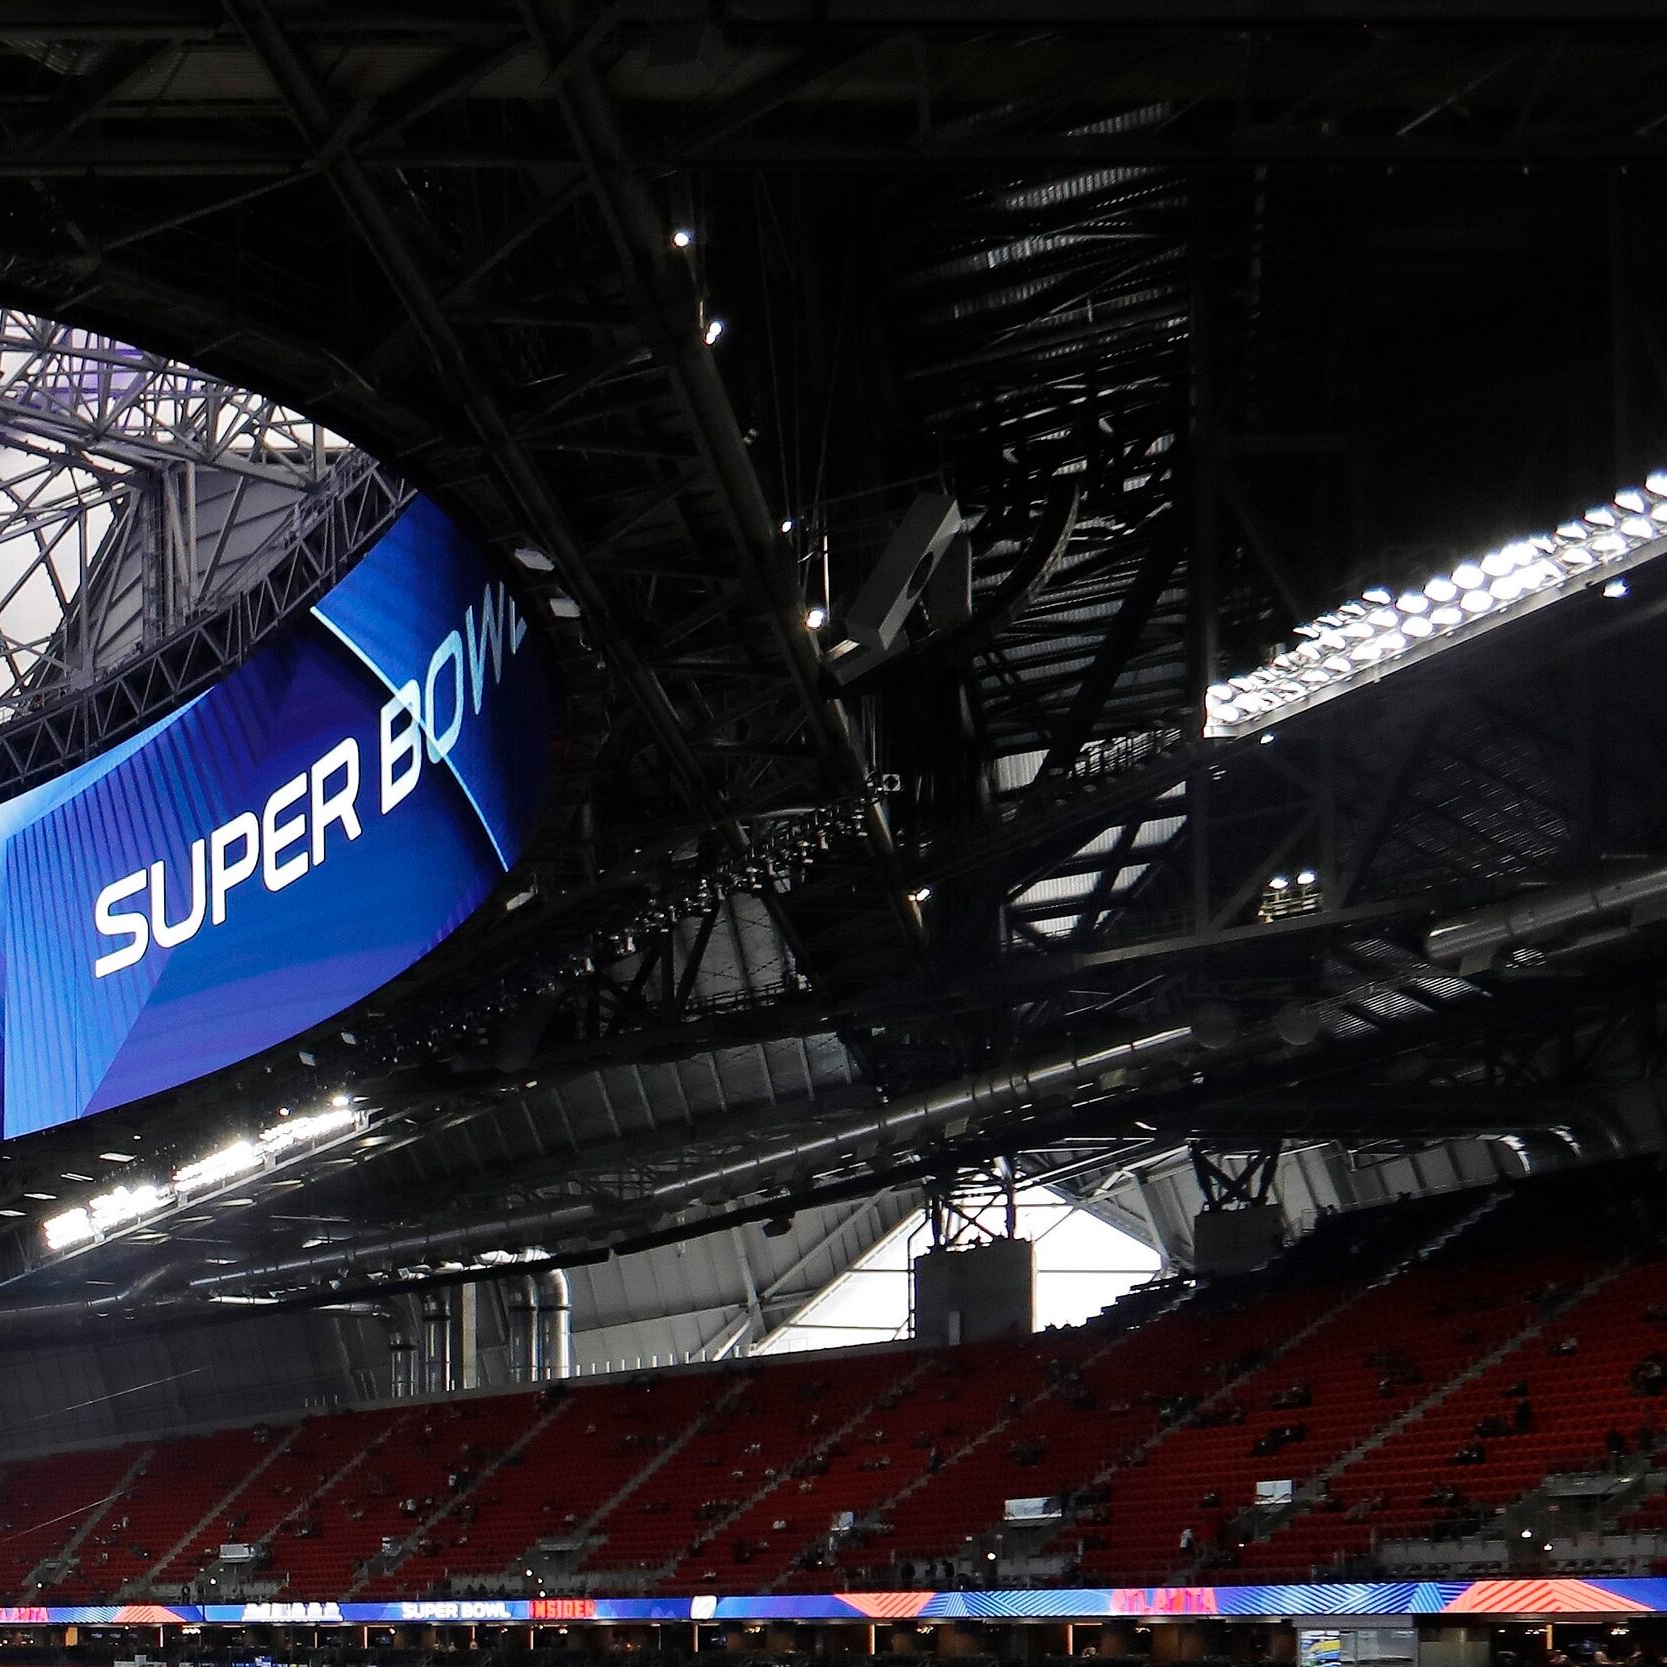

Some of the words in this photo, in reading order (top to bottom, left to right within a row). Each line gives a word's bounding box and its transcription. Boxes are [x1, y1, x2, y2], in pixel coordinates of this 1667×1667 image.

[94, 737, 362, 979] SUPER
[380, 581, 528, 814] BOWL
[402, 1601, 458, 1619] SUPER
[461, 1601, 512, 1619] BOWL
[529, 1599, 596, 1619] INSIDER
